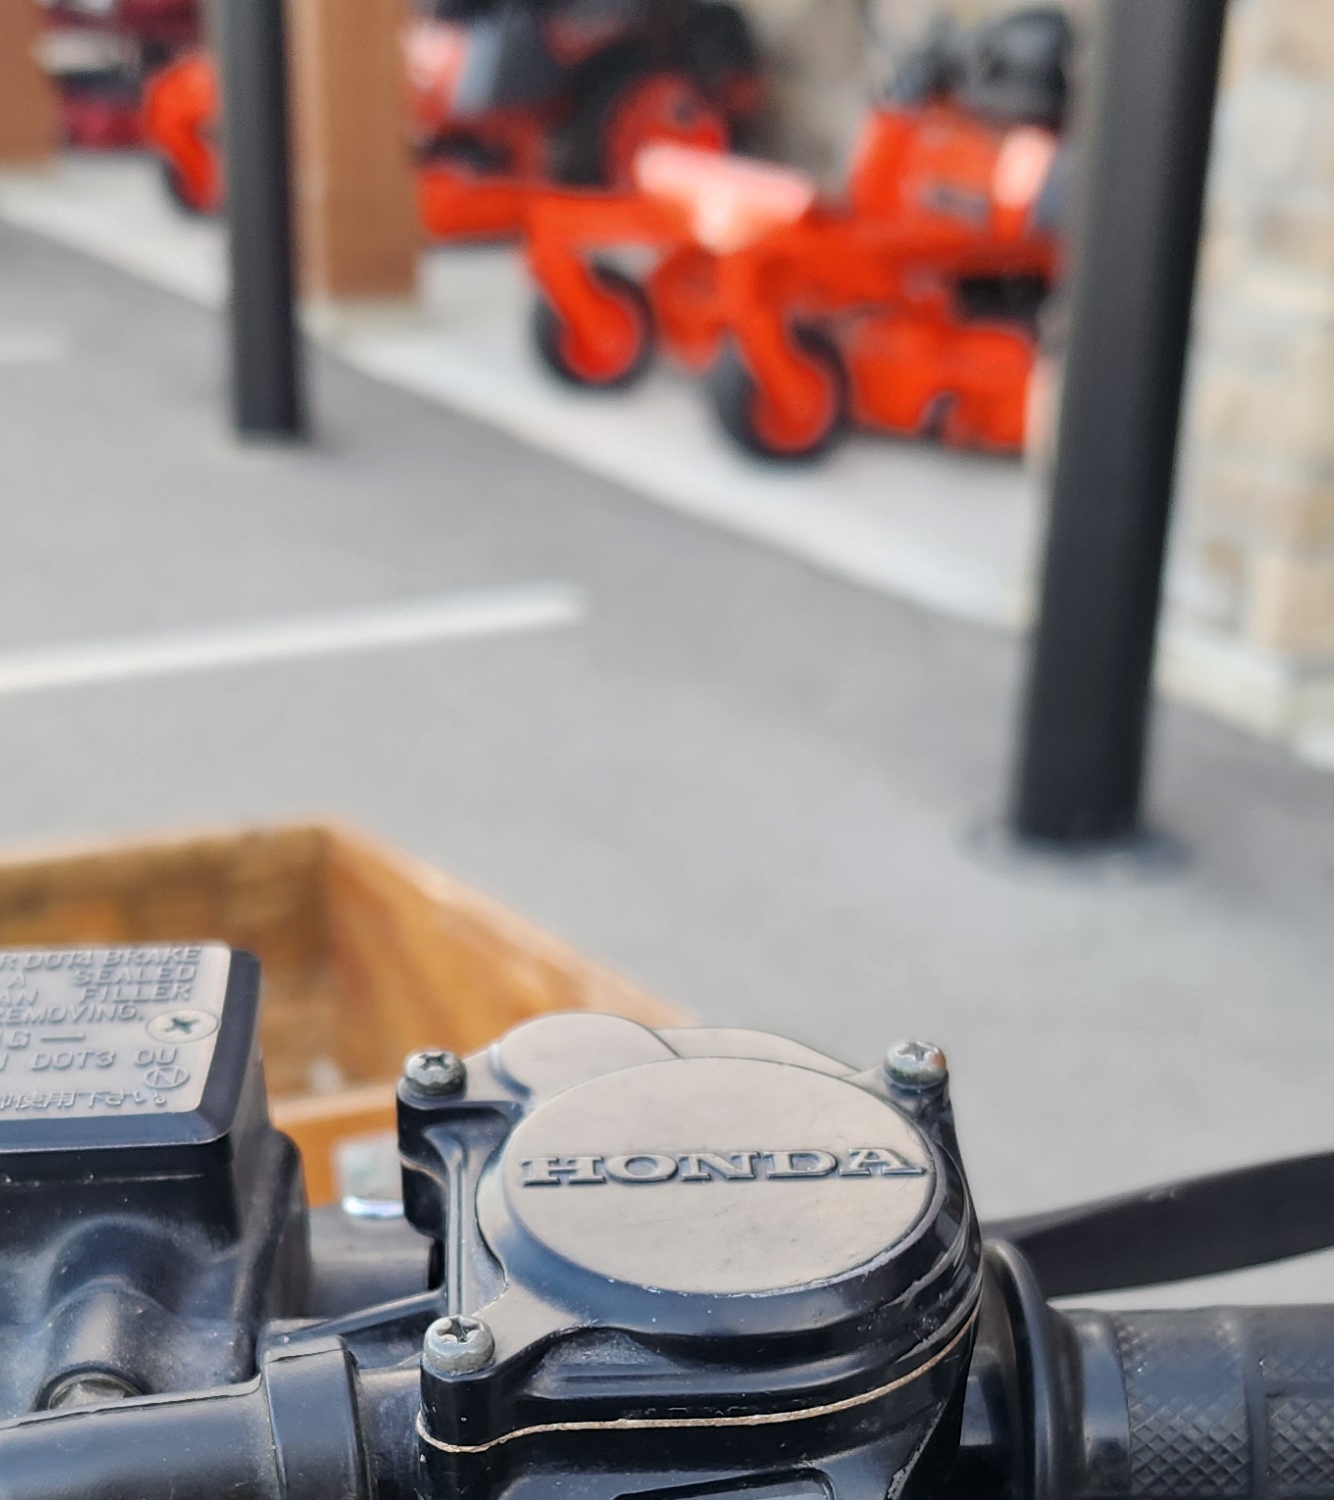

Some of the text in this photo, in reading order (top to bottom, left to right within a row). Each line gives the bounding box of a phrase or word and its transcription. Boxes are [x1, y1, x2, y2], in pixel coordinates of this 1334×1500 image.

[24, 951, 95, 972] DOT4
[104, 947, 203, 968] BRAKE
[7, 971, 27, 989] A
[72, 966, 197, 988] SEALED
[79, 984, 192, 1005] FILLER
[31, 1050, 117, 1072] DOT3
[133, 1047, 181, 1067] OU
[520, 1147, 926, 1187] HONDA
